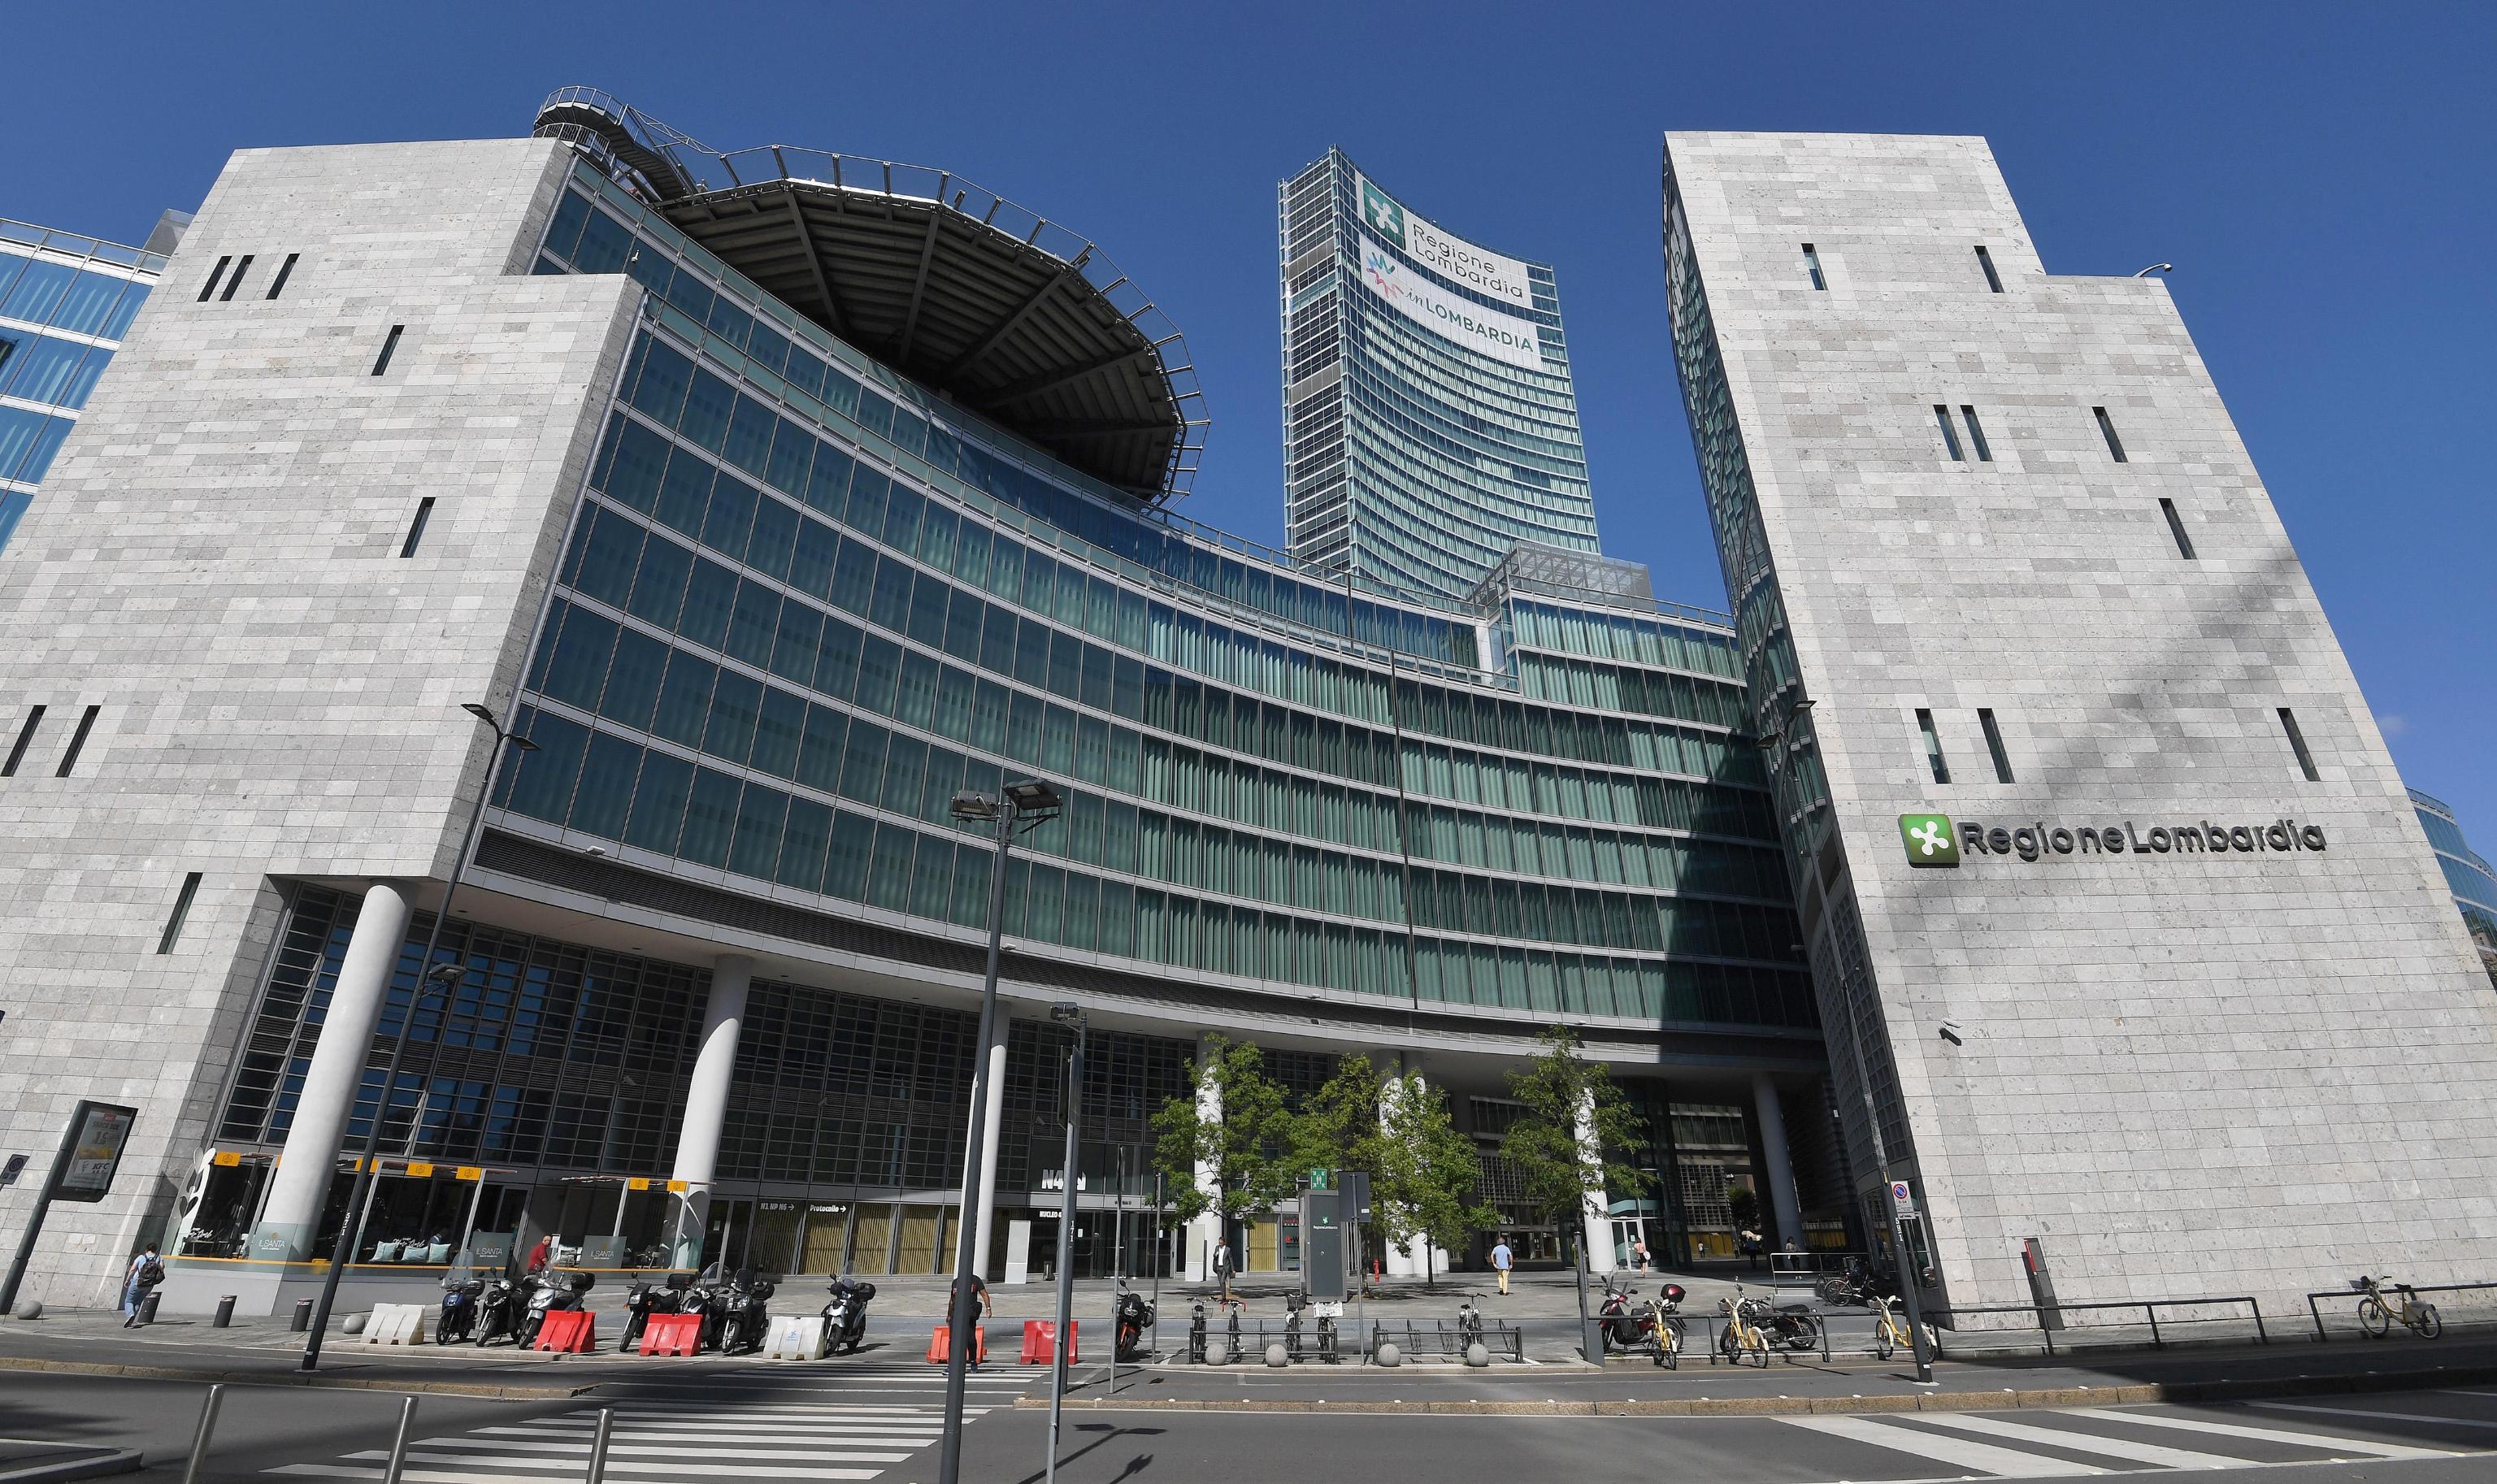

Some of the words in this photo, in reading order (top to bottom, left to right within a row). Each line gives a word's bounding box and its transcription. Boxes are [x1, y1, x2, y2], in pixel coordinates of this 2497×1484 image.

[1413, 223, 1496, 274] Regione
[1414, 239, 1523, 299] Lombardia
[1041, 1169, 1064, 1190] N4
[810, 1204, 839, 1213] Protocollo
